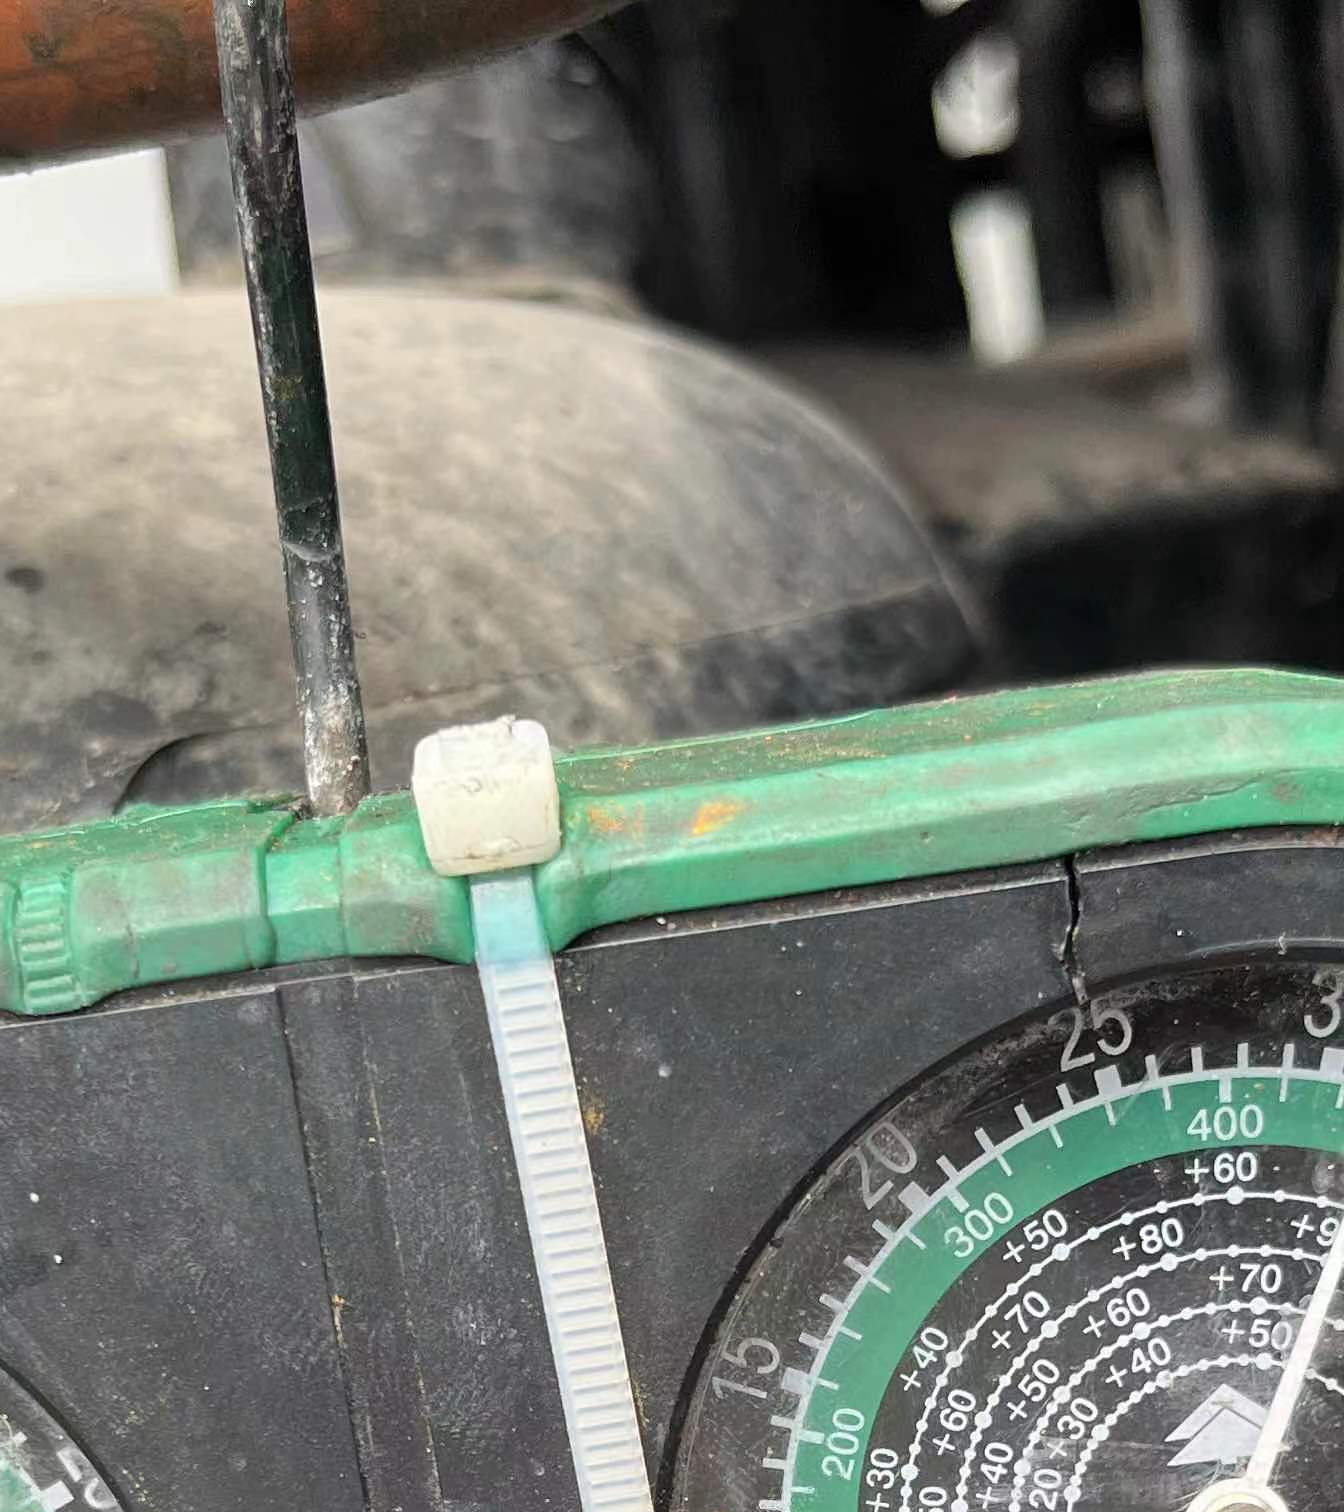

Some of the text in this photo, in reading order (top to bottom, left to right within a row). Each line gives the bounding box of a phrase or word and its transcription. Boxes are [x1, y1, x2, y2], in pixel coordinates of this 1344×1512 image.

[1048, 1000, 1133, 1073] 25
[1186, 1104, 1264, 1142] 400
[855, 1121, 918, 1211] 20
[1184, 1151, 1257, 1184] +60
[944, 1192, 1014, 1259] 300
[1002, 1209, 1068, 1263] +50
[1112, 1217, 1184, 1261] +80
[1209, 1264, 1282, 1294] +70
[991, 1290, 1050, 1350] +70
[1082, 1287, 1151, 1339] +60
[1221, 1319, 1294, 1353] +50
[712, 1337, 780, 1400] 15
[900, 1327, 949, 1391] +40
[1006, 1359, 1060, 1421] +50
[1105, 1337, 1171, 1388] +40
[822, 1408, 865, 1481] 200
[933, 1389, 977, 1455] +60
[1048, 1397, 1098, 1459] +30
[975, 1442, 1013, 1509] +40
